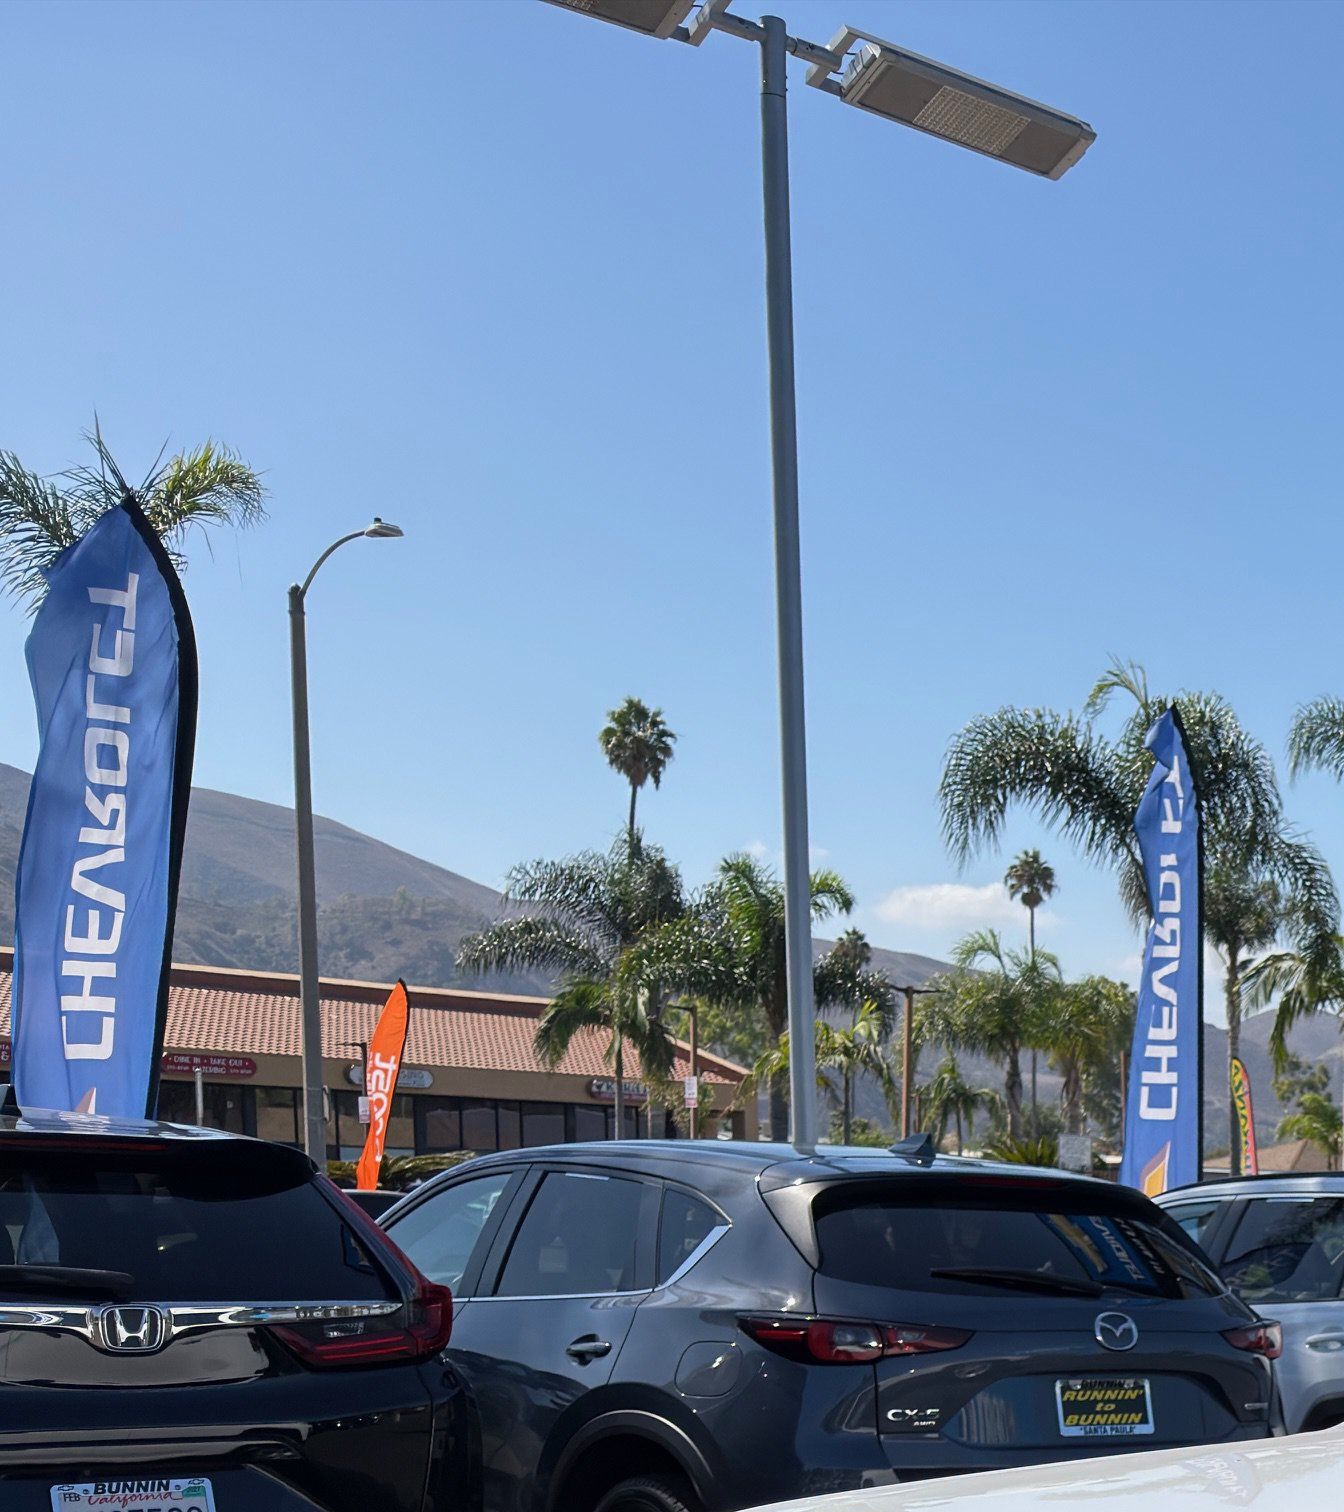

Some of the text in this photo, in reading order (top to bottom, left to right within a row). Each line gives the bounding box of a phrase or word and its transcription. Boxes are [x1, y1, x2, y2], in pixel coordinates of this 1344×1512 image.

[1062, 1389, 1144, 1401] RUNNIN'
[1095, 1402, 1116, 1411] to
[886, 1408, 940, 1422] CX-5
[1065, 1412, 1143, 1426] BUNNIN
[93, 1479, 171, 1495] BUNNIN
[63, 1493, 81, 1502] FEB
[87, 1491, 184, 1508] California
